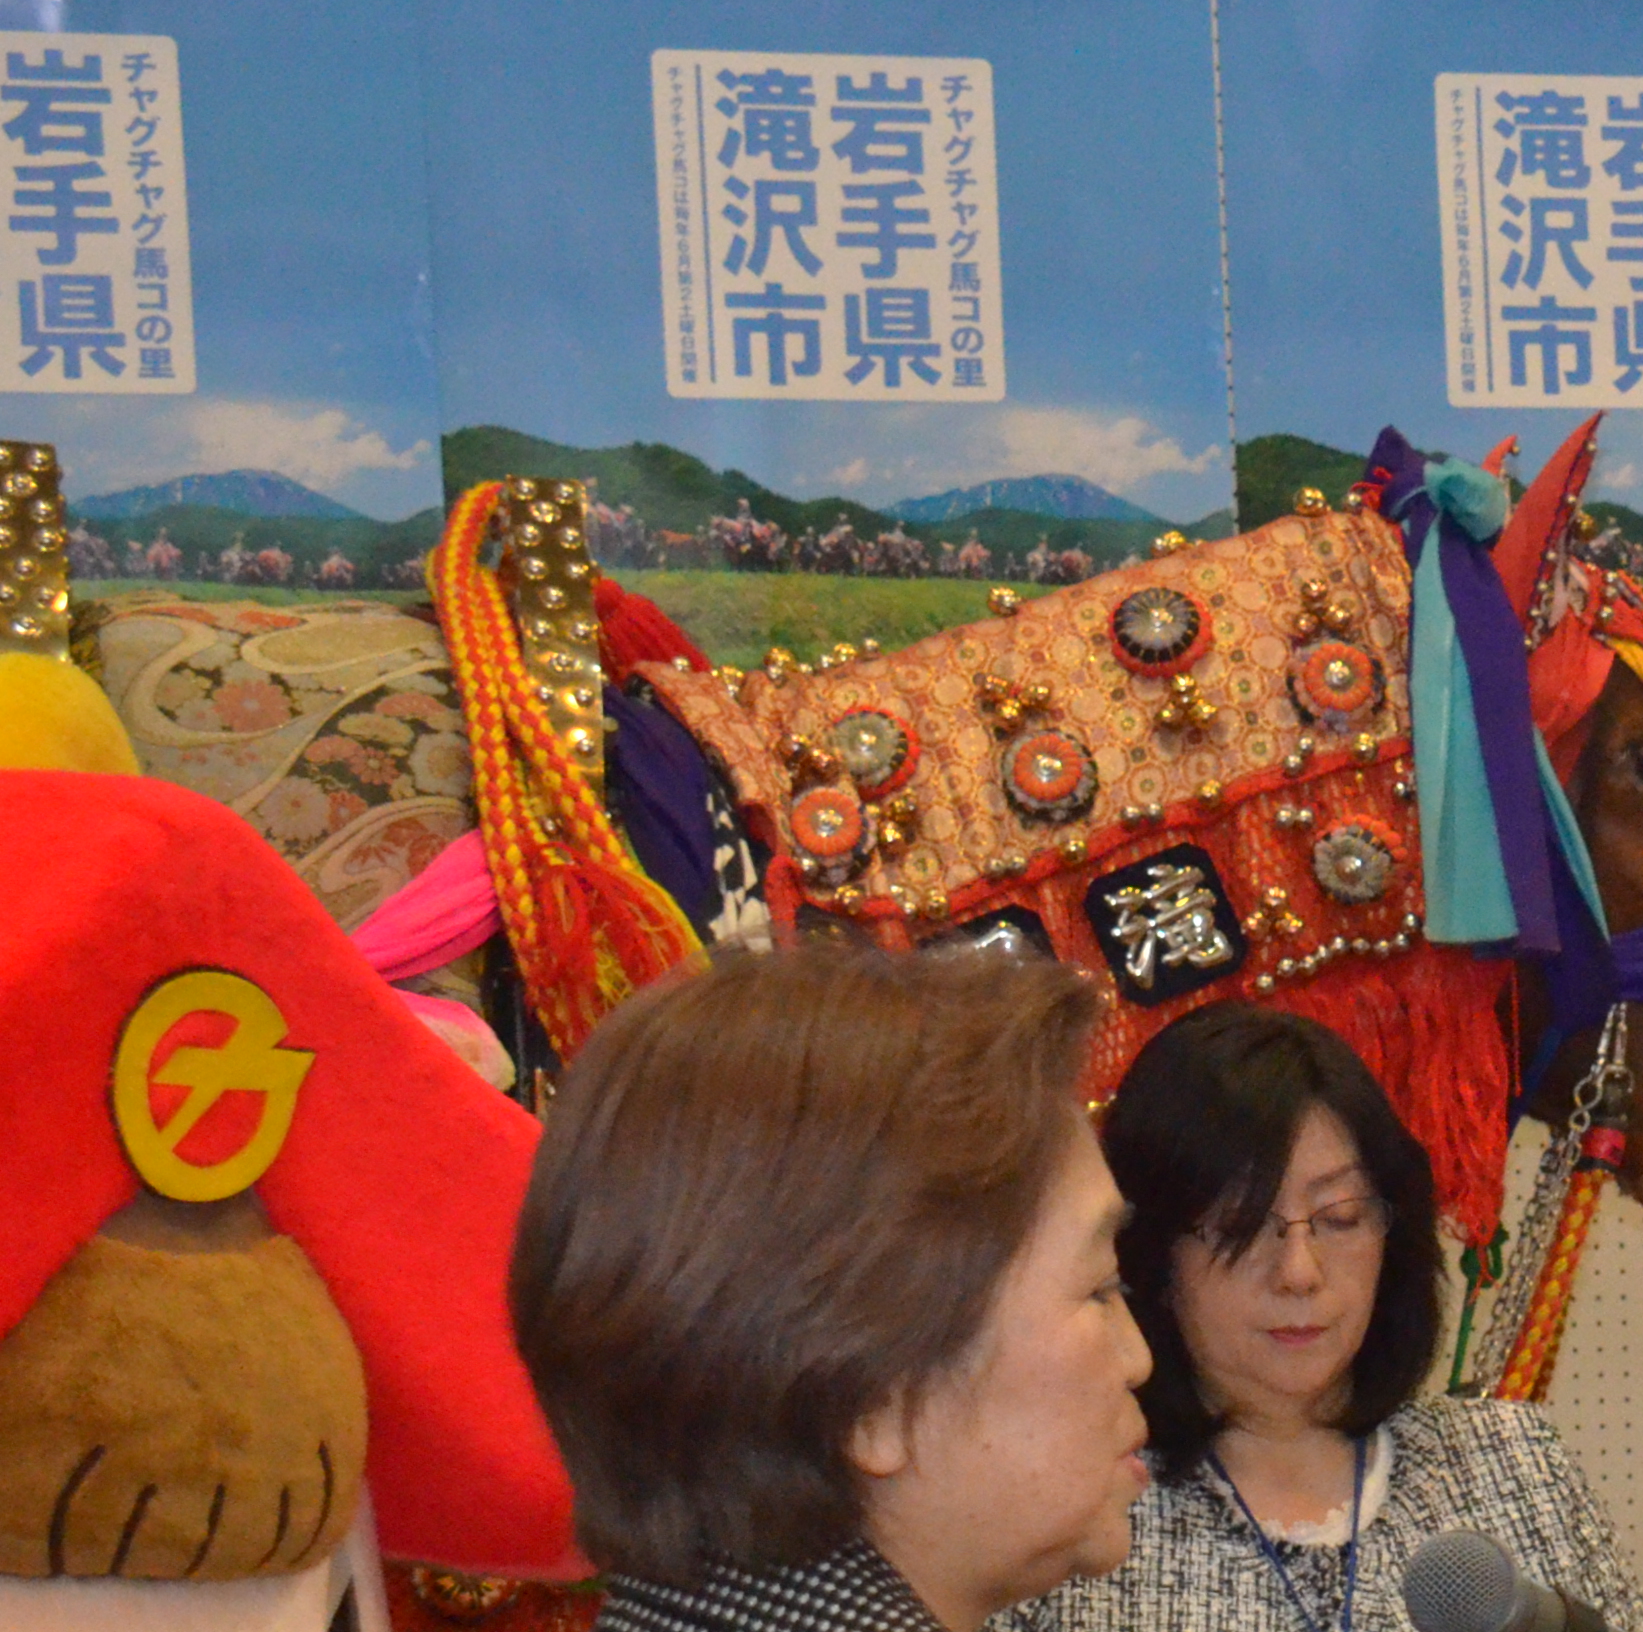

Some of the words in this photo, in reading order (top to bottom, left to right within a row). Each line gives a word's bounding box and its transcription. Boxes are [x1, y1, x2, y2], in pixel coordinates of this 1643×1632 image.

[2, 50, 126, 381] 岩手県
[121, 51, 175, 381] チャグチャグ馬コの里
[715, 66, 826, 387] 滝沢市
[830, 72, 942, 389] 岩手県
[939, 74, 986, 389] チャグチャグ馬コの里
[1493, 90, 1597, 395] 滝沢市
